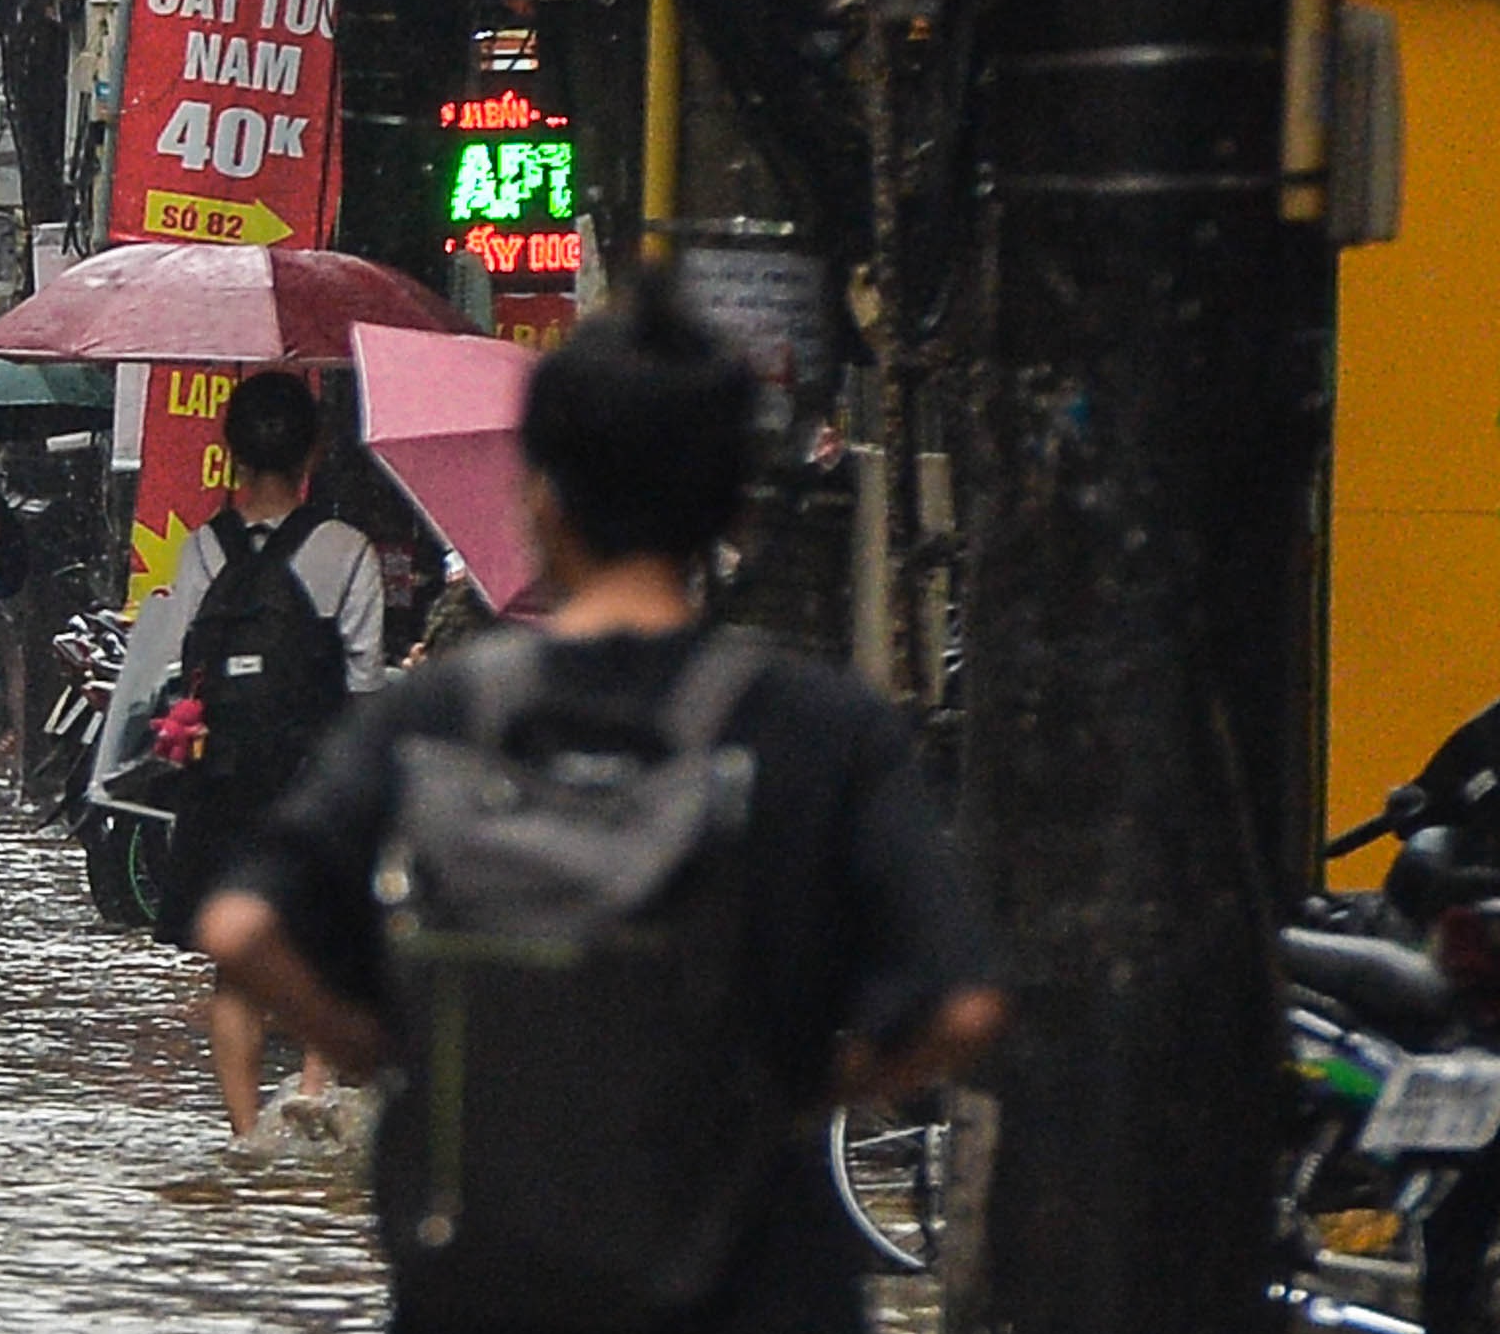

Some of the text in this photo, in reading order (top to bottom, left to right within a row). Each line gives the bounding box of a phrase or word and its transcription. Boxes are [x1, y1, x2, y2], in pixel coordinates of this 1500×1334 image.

[183, 30, 302, 95] NAM
[160, 200, 244, 239] SỐ 82
[168, 370, 239, 419] LAP
